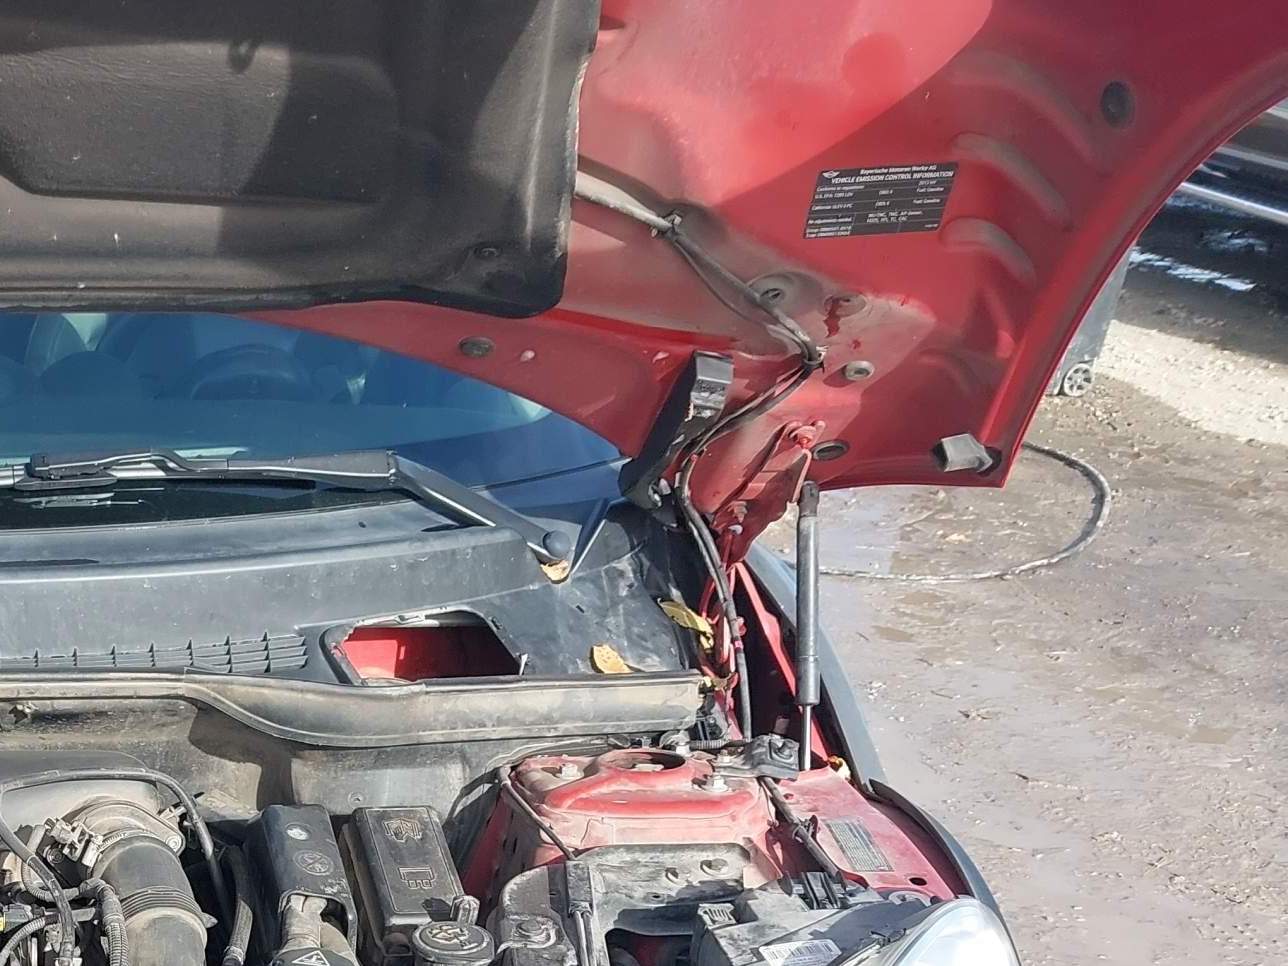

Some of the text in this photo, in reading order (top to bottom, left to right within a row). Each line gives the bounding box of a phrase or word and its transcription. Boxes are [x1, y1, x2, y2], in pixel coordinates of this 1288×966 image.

[832, 176, 855, 184] VEHICLE
[856, 174, 885, 182] EMISSION
[913, 171, 954, 179] INFORMATION
